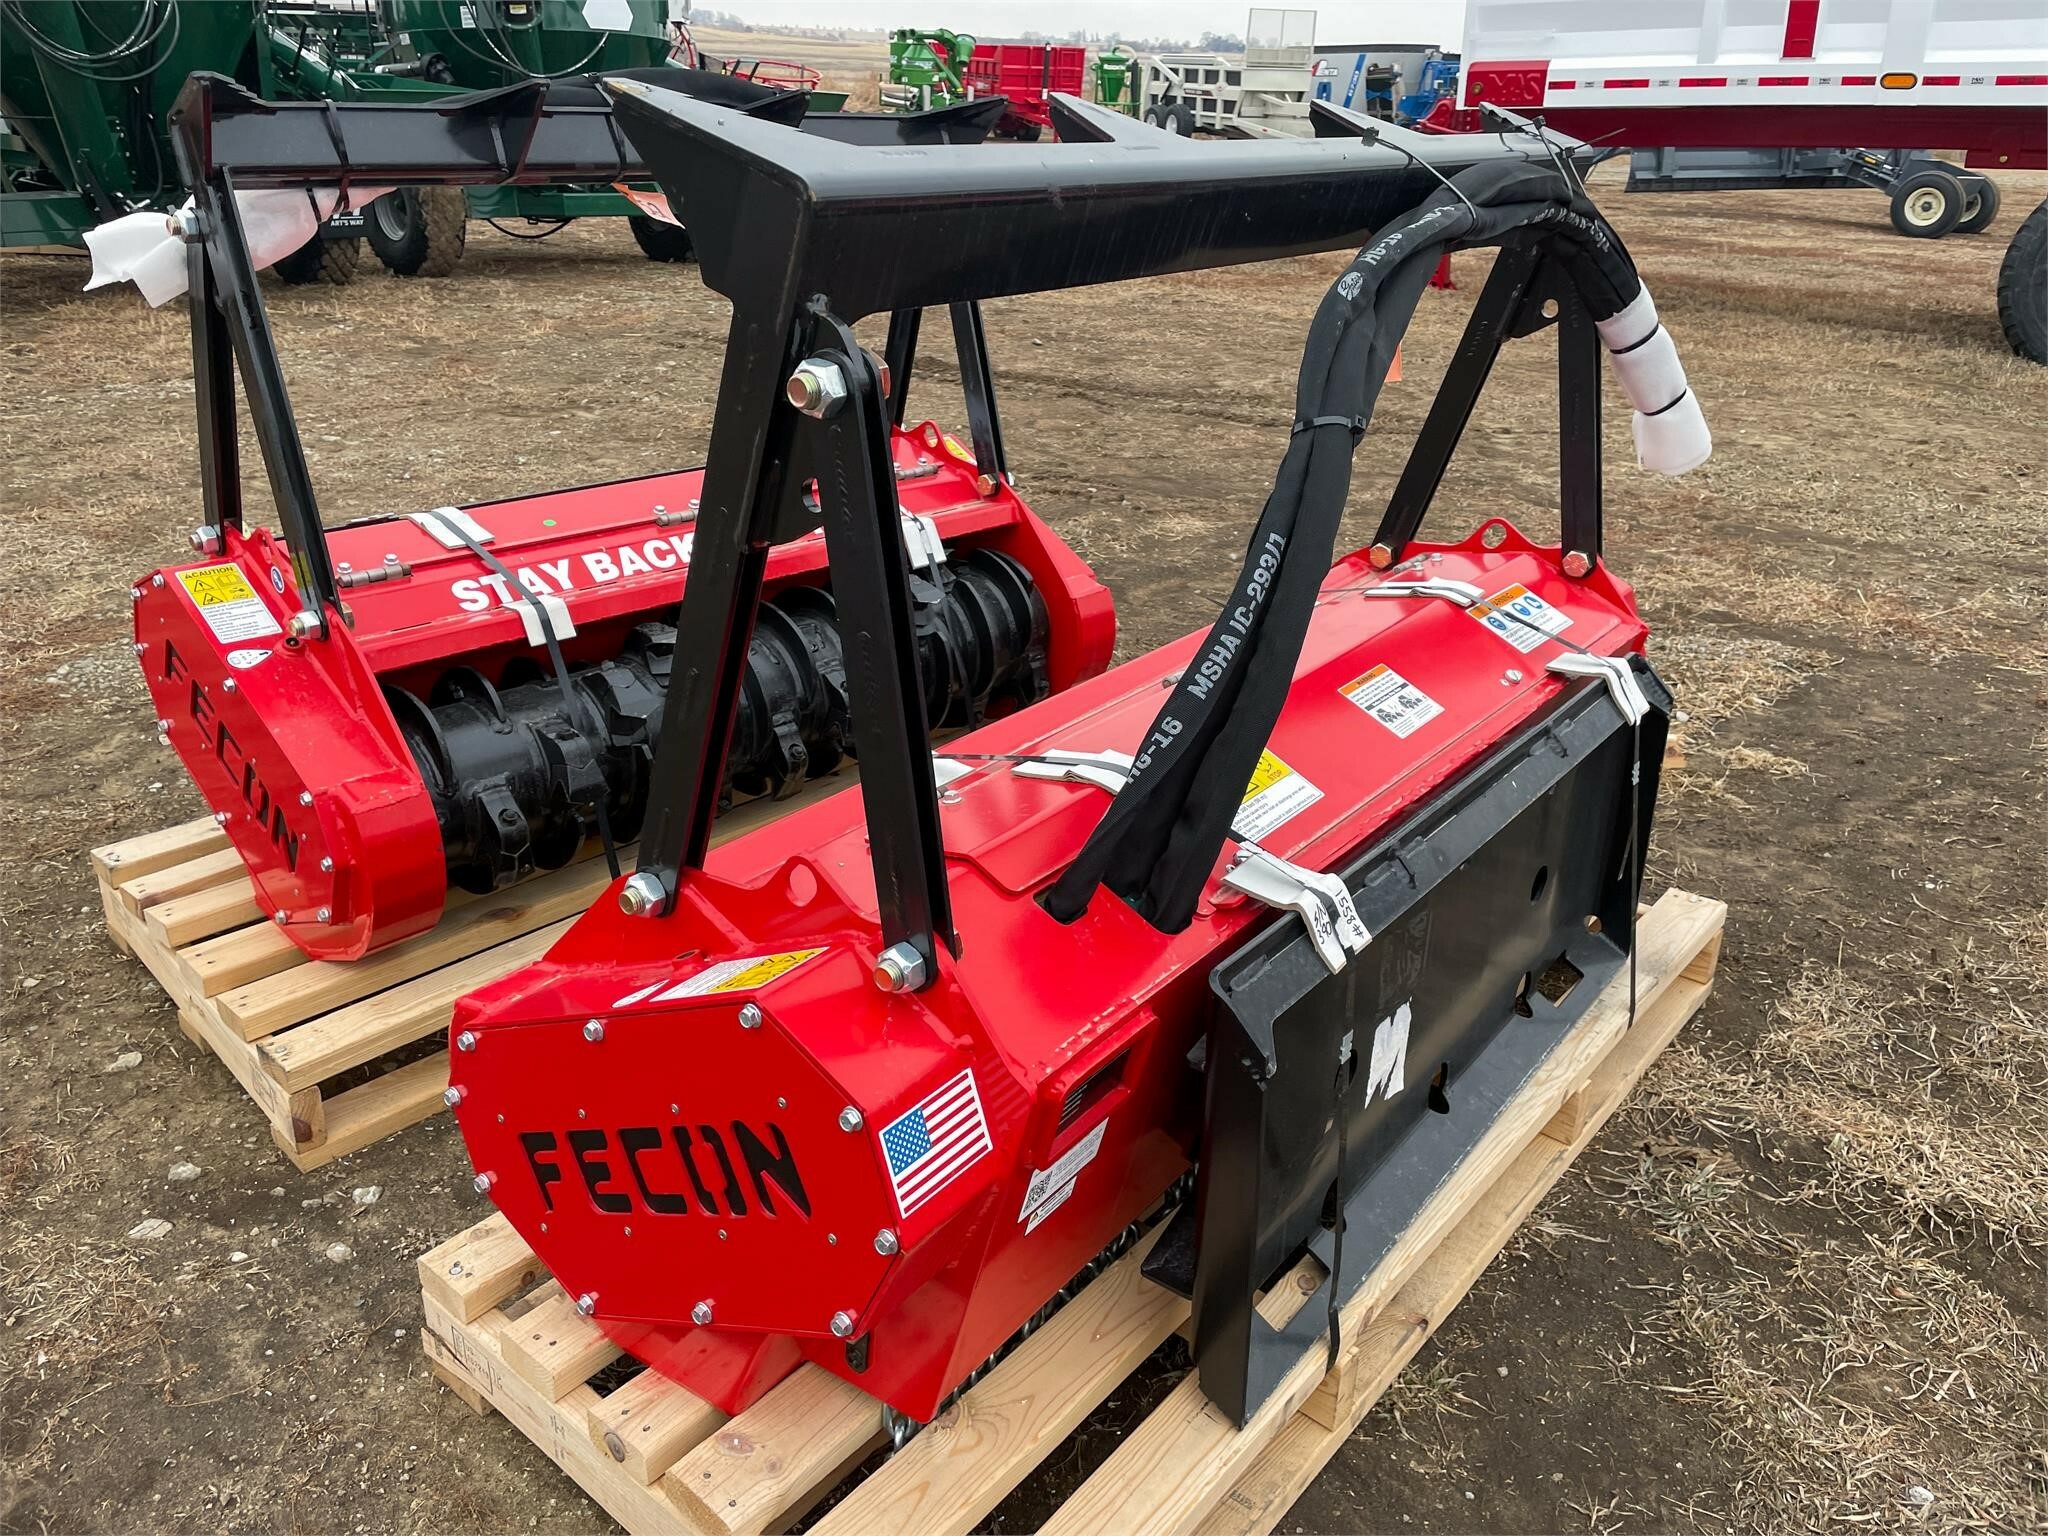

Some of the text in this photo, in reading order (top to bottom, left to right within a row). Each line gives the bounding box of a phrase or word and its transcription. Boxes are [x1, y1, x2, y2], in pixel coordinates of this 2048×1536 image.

[330, 219, 349, 227] ART'S
[191, 566, 235, 579] CAUTION
[451, 531, 696, 613] STAY BACK
[1186, 633, 1243, 701] MSHA
[1228, 532, 1287, 635] IC-293/1
[164, 638, 299, 875] FECON
[518, 1119, 812, 1223] FECON
